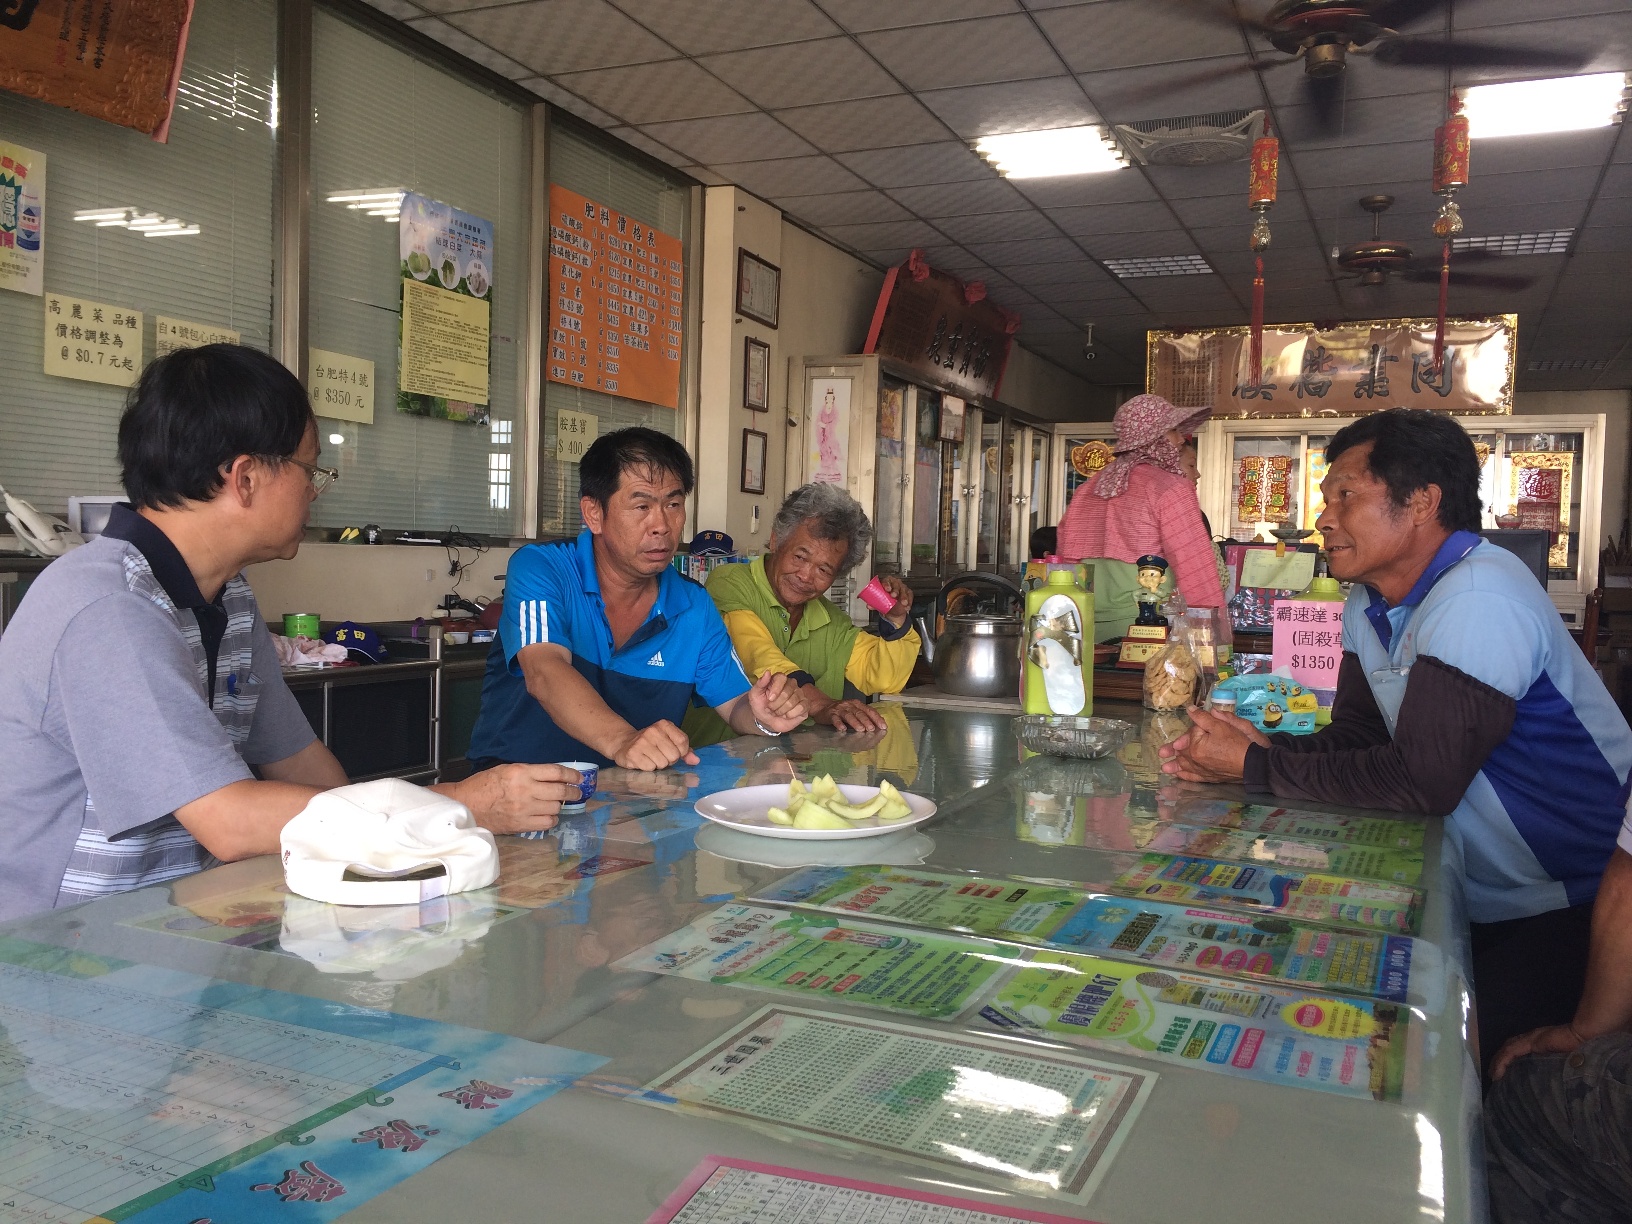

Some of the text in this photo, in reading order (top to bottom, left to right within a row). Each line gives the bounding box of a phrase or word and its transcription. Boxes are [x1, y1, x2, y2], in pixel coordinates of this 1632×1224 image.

[48, 299, 138, 330] 高麗菜品種
[55, 323, 124, 349] 價格調整為
[109, 355, 134, 372] 元起
[315, 364, 369, 388] 台肥特4號
[325, 387, 351, 406] $350
[354, 395, 365, 408] 元
[568, 440, 583, 455] 400
[1276, 605, 1328, 623] 霸速達
[1291, 654, 1335, 669] $1350
[366, 1091, 394, 1108] 2
[274, 1130, 316, 1146] 3
[178, 1174, 214, 1193] 4
